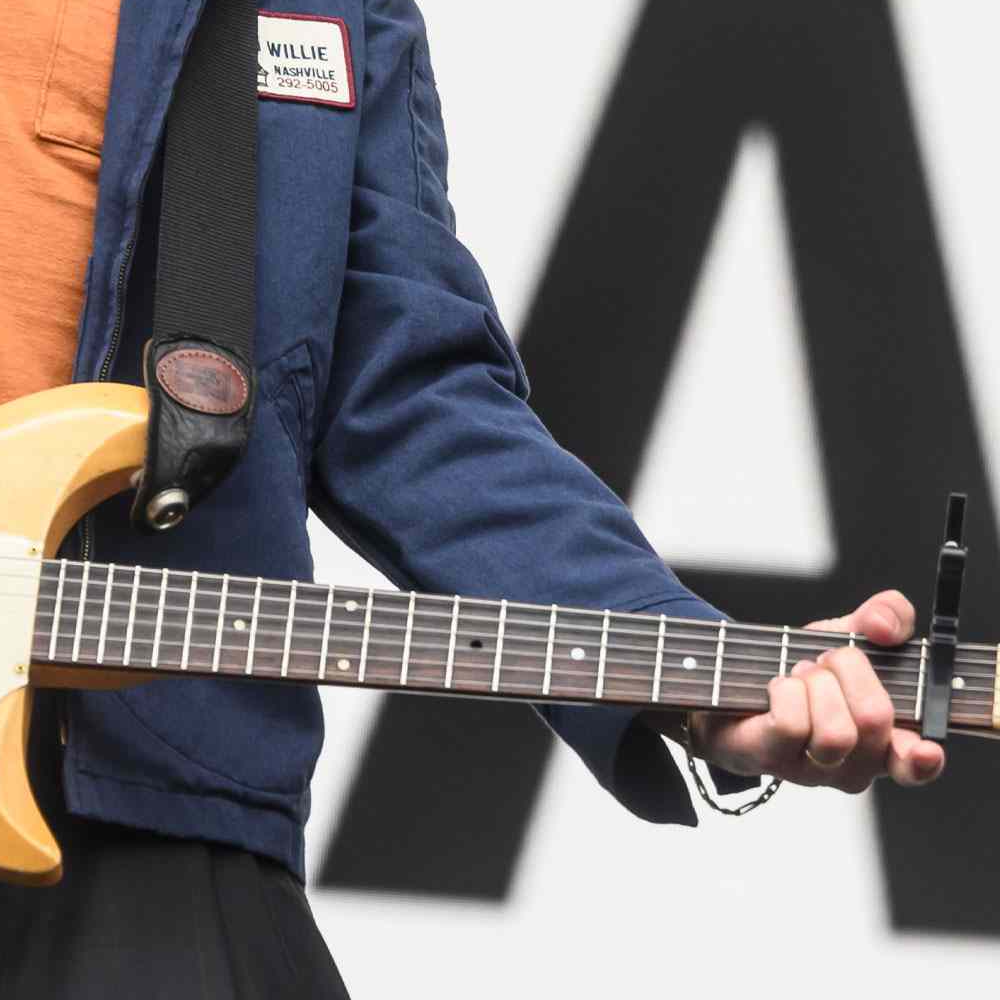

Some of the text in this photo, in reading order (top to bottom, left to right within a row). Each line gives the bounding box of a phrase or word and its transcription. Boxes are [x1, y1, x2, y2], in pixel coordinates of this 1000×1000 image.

[266, 40, 329, 62] WILLIE
[273, 65, 336, 81] NASHVILLE
[276, 76, 339, 93] 292-5005
